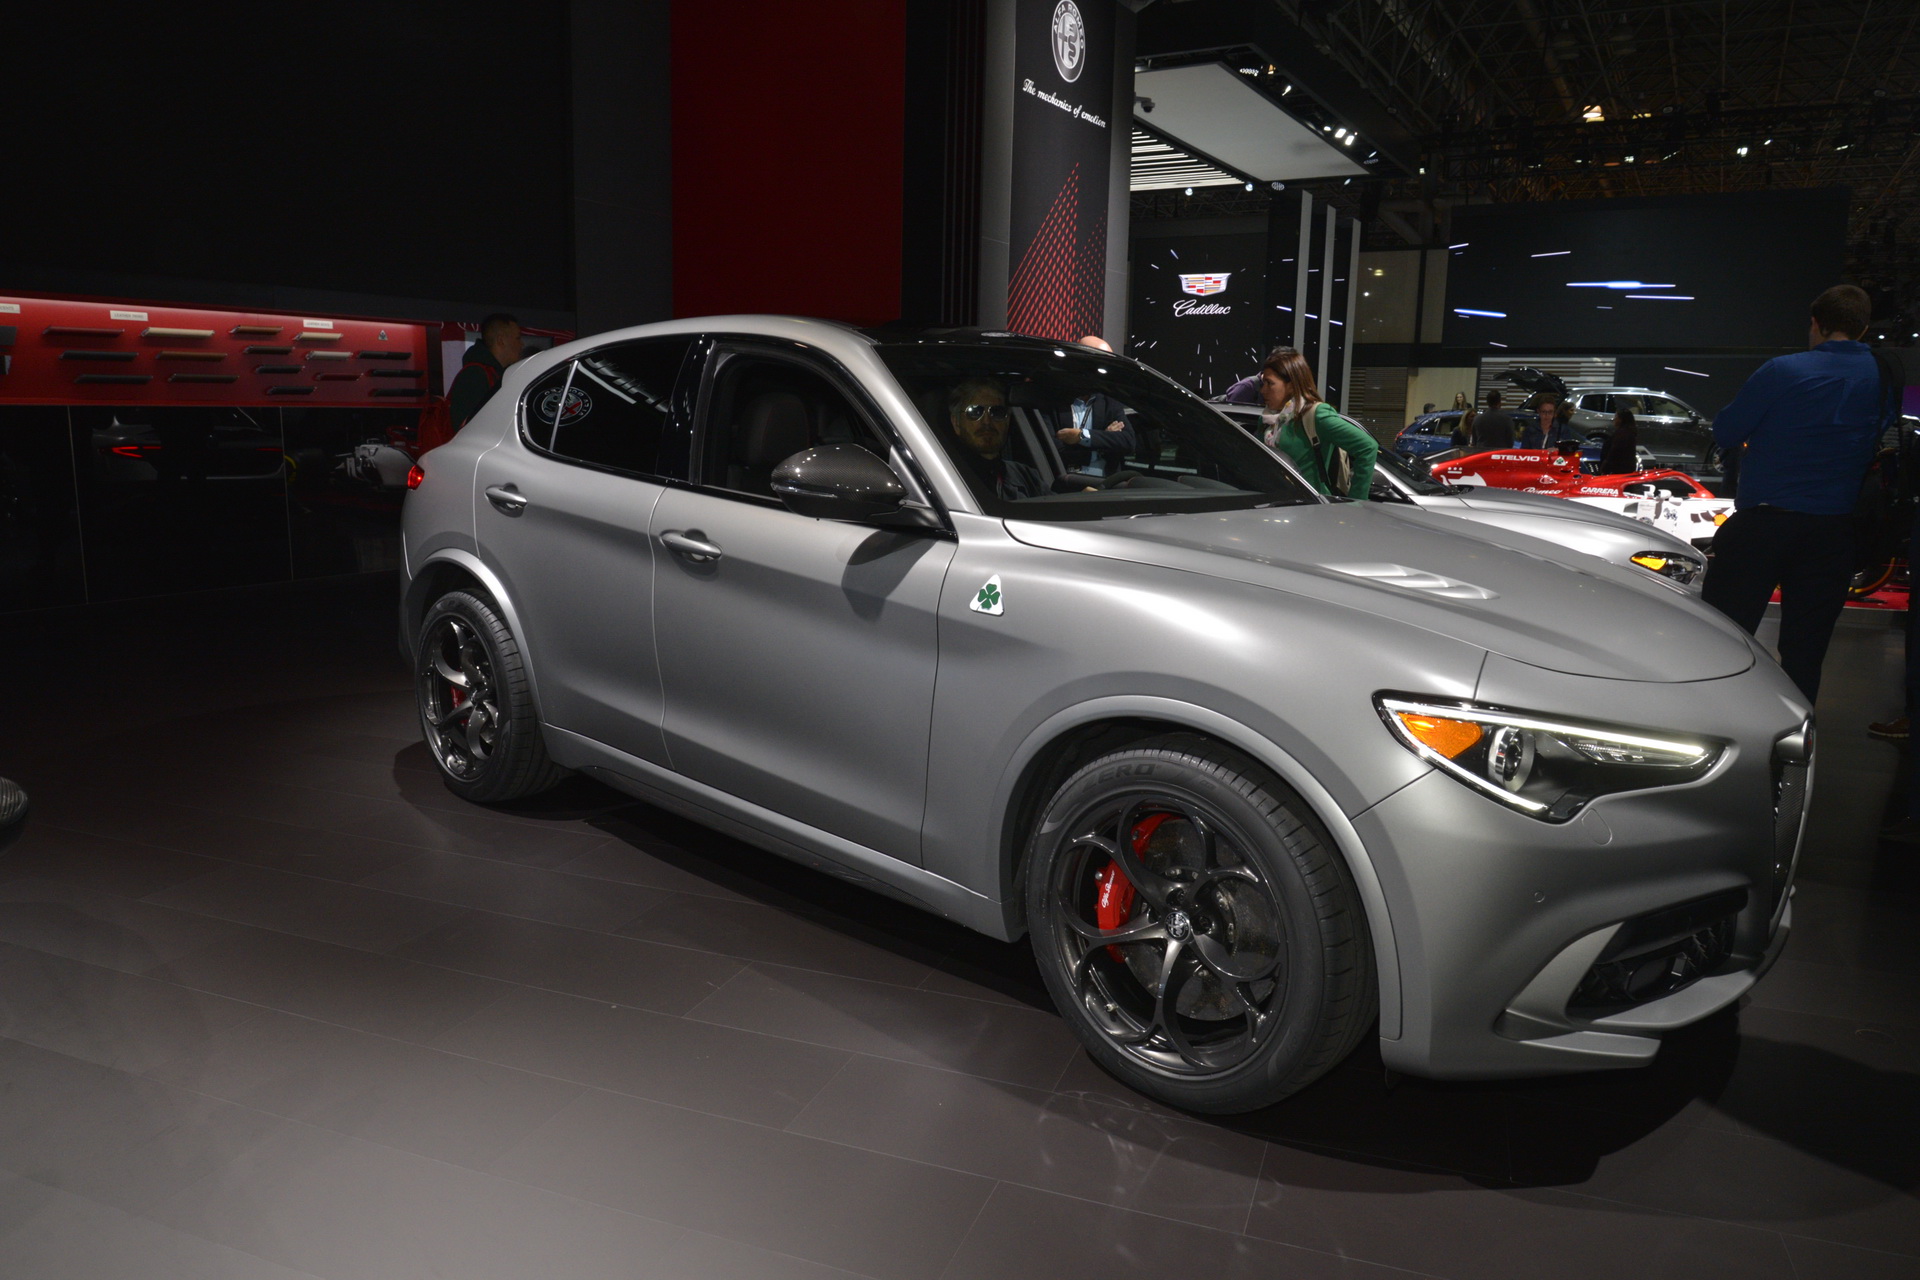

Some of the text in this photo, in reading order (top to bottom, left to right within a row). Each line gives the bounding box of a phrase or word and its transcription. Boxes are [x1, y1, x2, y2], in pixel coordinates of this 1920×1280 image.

[1053, 3, 1085, 50] ALFA ROMEO
[1022, 78, 1106, 128] The mechanics of emotion
[1173, 299, 1232, 318] Cadillac
[1491, 454, 1540, 462] STELVIO
[1580, 486, 1619, 495] CARRERA
